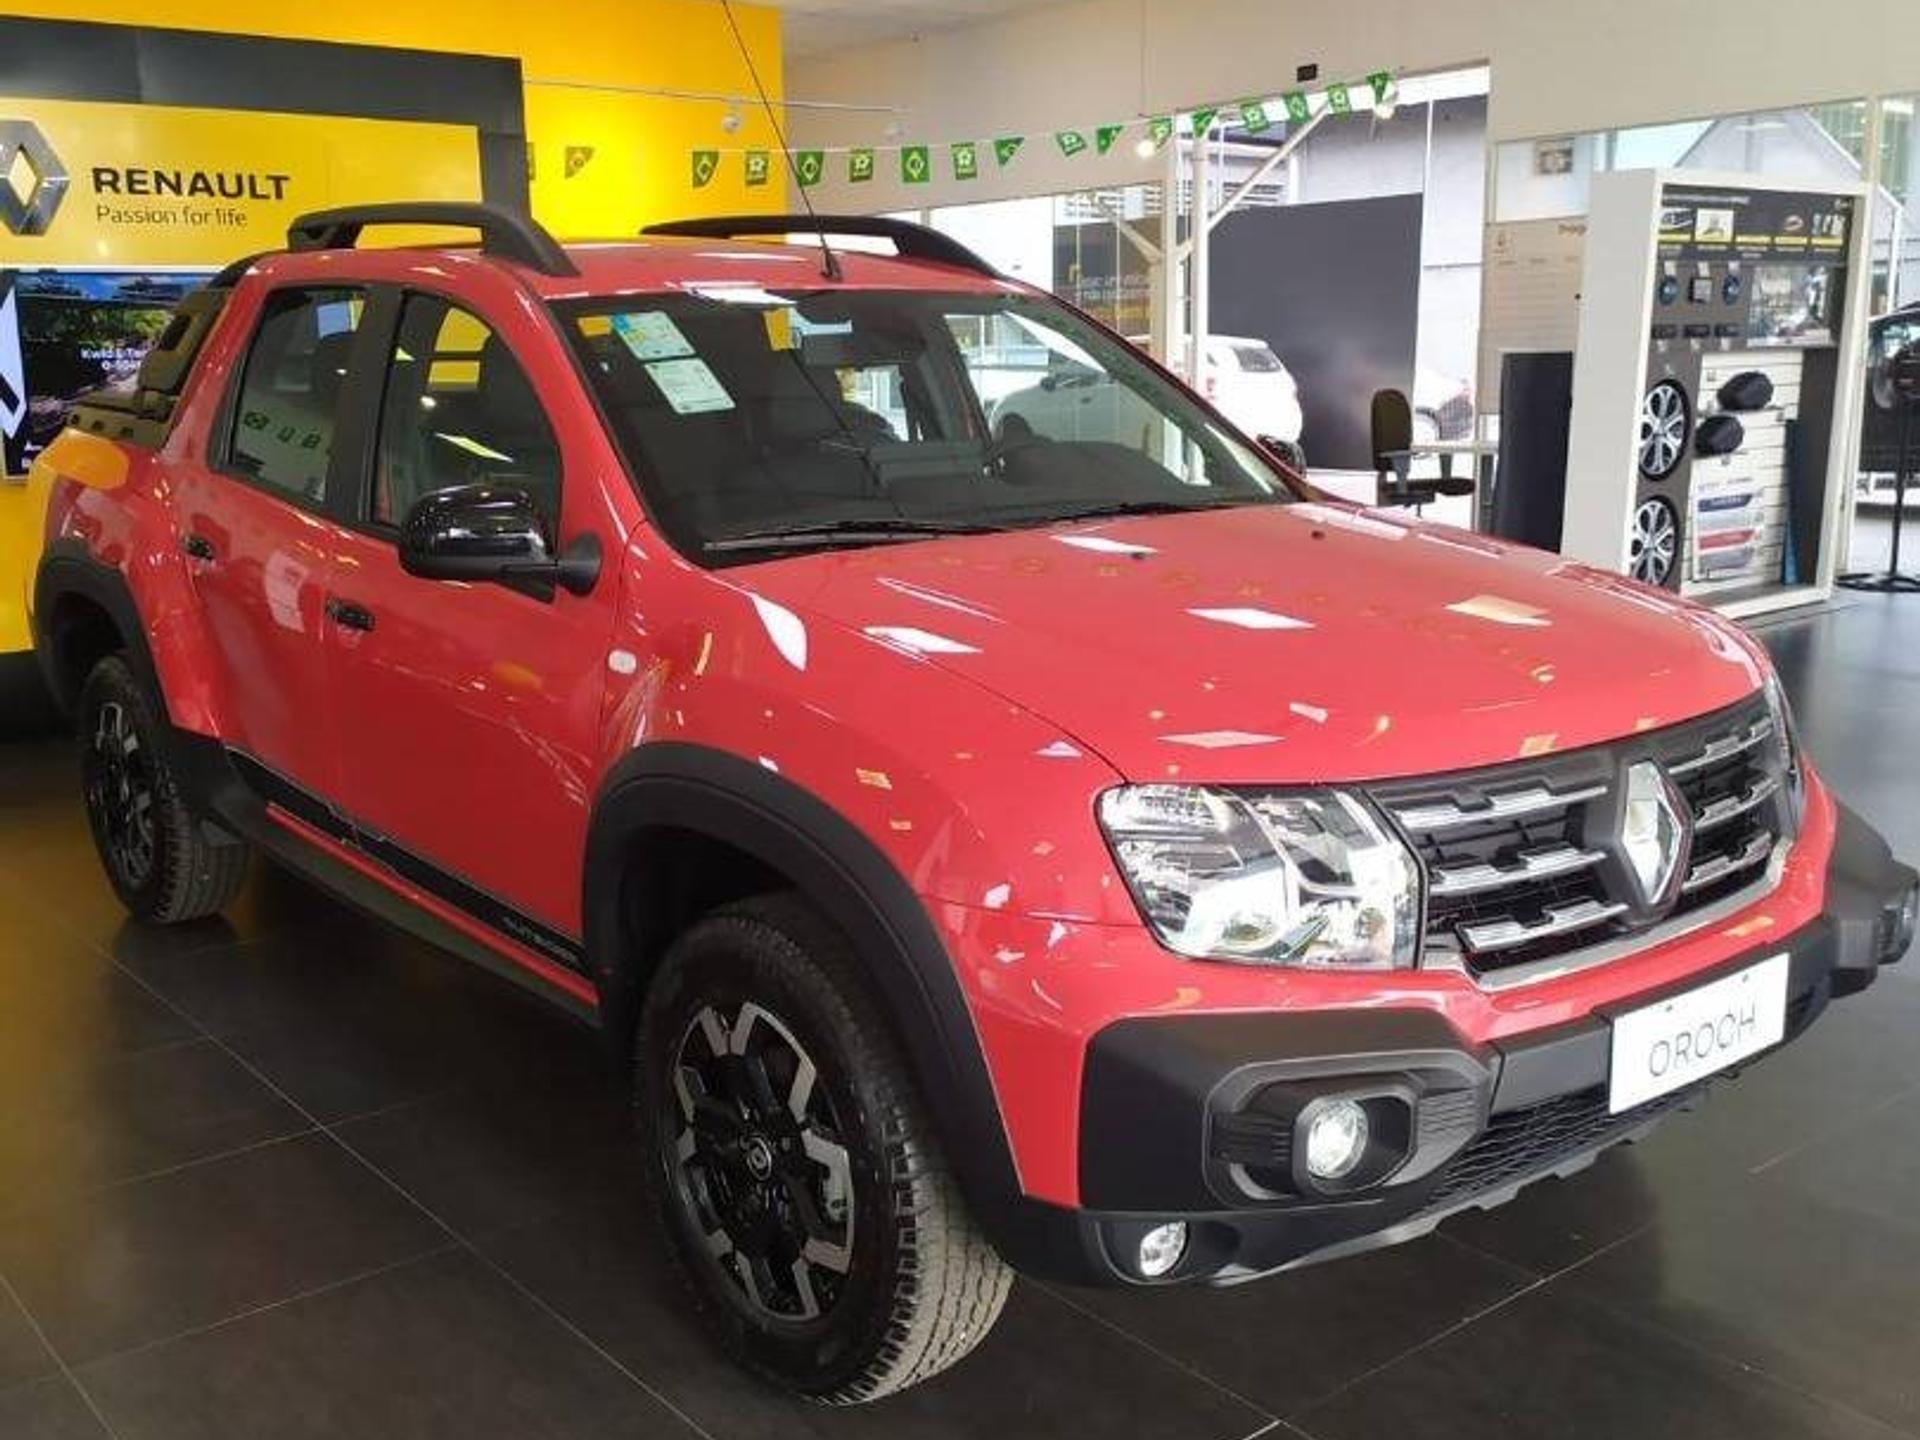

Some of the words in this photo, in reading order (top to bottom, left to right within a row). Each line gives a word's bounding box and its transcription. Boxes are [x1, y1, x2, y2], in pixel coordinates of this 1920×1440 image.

[92, 167, 291, 200] RENAULT
[96, 205, 177, 224] Passion
[183, 206, 211, 226] for
[216, 208, 247, 226] life
[1648, 1001, 1755, 1077] OROCH
